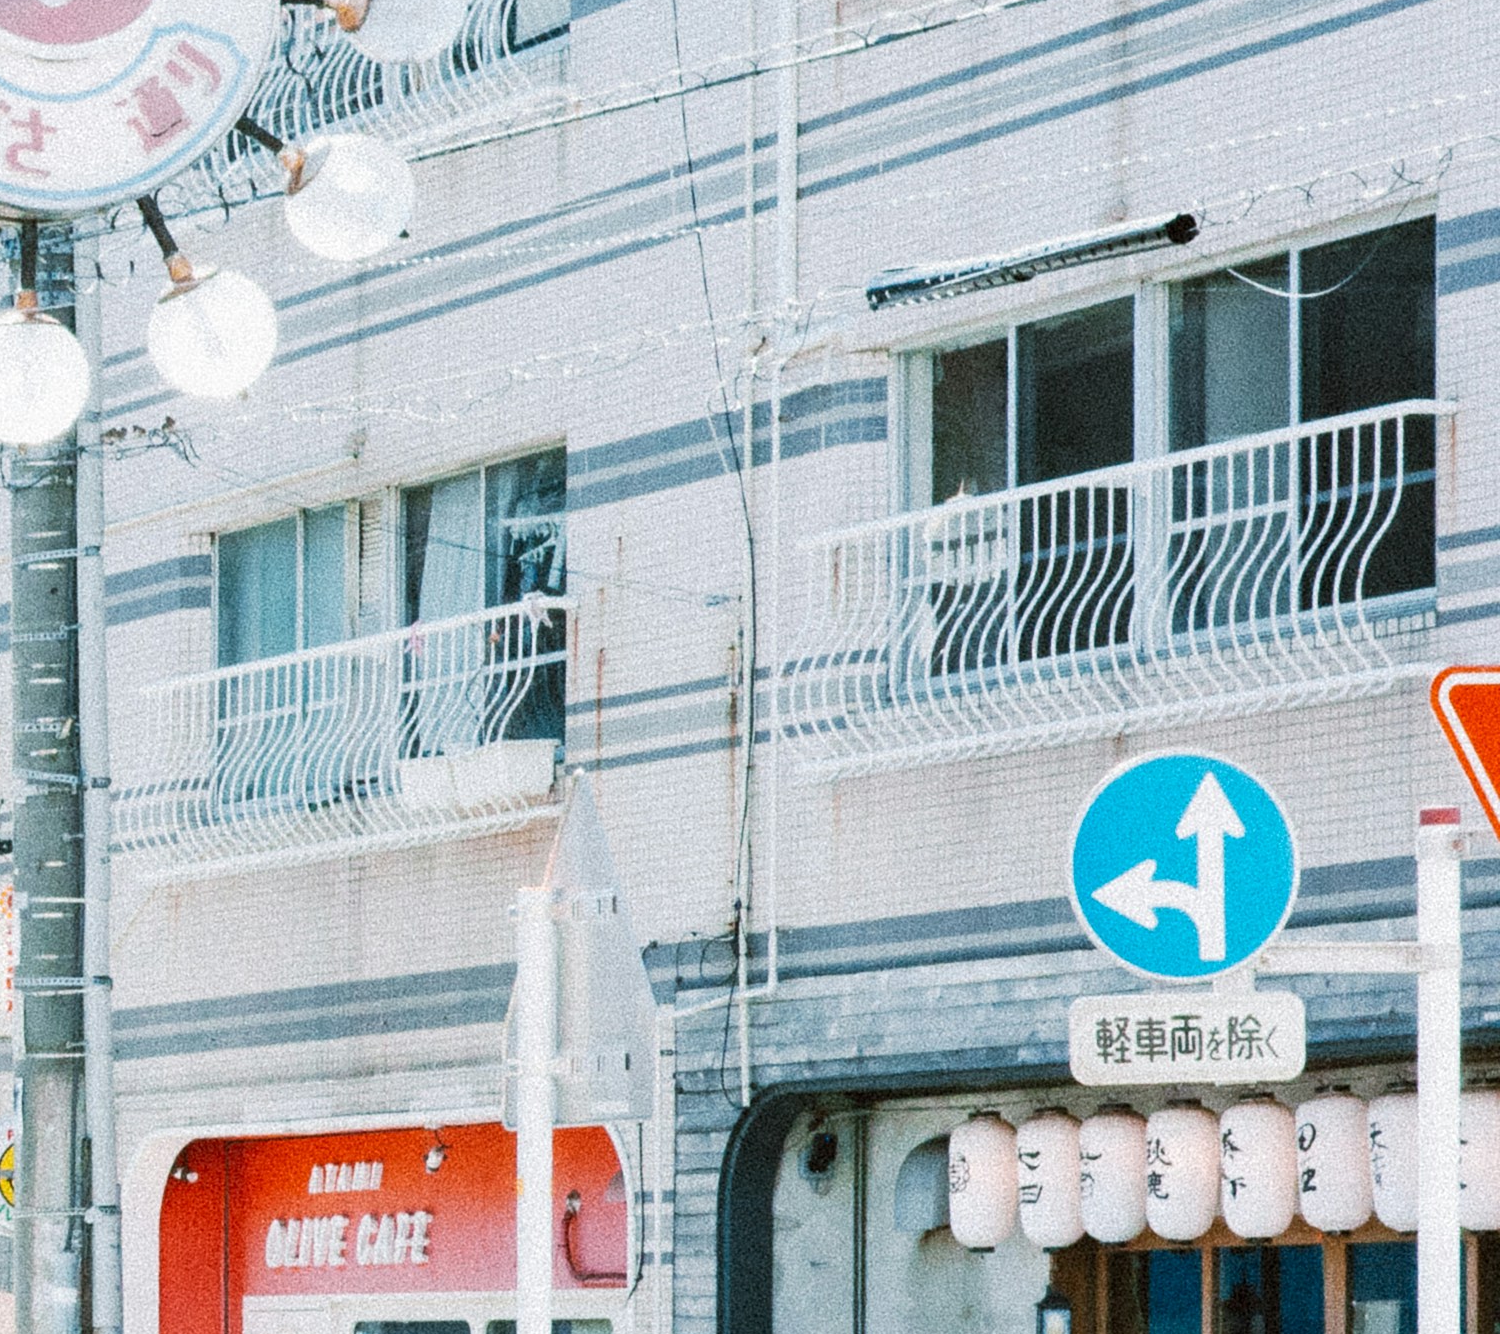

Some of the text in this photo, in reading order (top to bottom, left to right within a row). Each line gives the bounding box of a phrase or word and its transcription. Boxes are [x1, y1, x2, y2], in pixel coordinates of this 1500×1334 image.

[1094, 1013, 1280, 1064] 軽車両を除く
[307, 1160, 384, 1195] ATAMI
[265, 1209, 434, 1269] OLIVE CAFE
